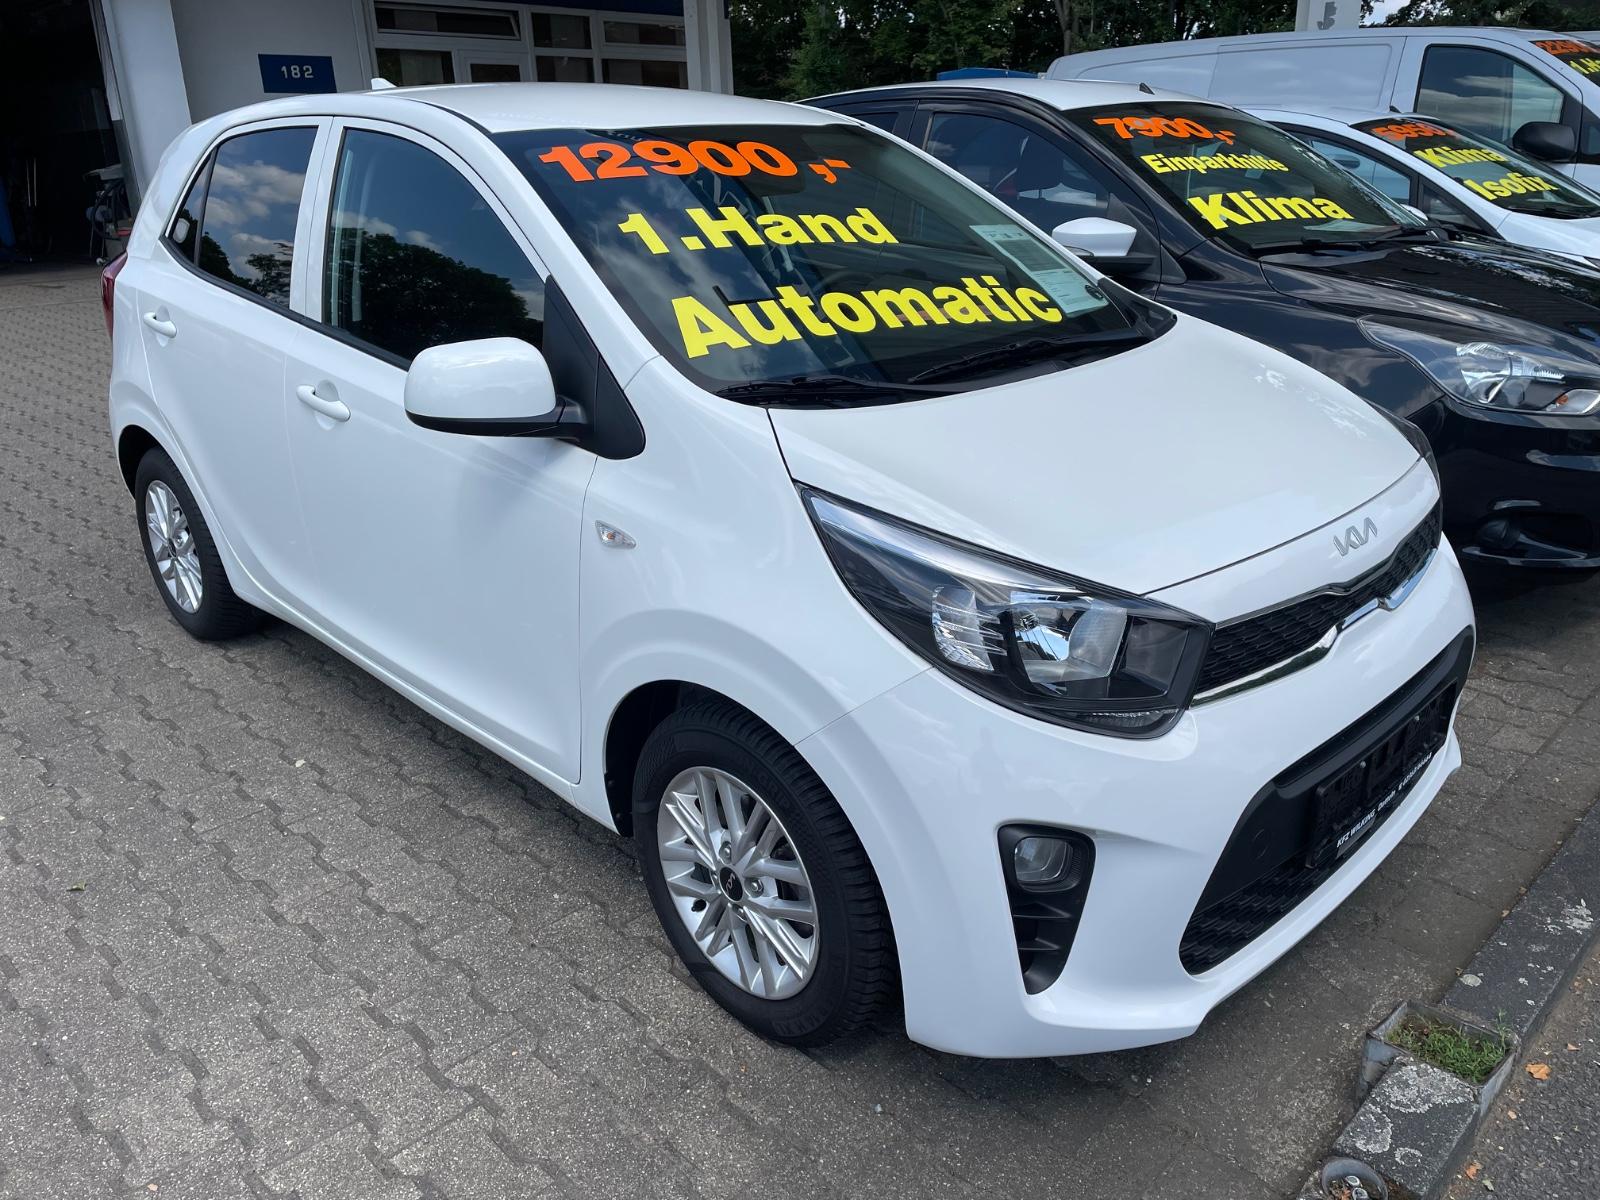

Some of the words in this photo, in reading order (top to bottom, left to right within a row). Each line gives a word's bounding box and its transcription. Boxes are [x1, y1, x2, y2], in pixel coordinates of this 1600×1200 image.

[281, 65, 314, 79] 182
[1140, 153, 1289, 174] Einparkhilfe
[1413, 146, 1508, 168] Klima
[1463, 172, 1559, 201] Isofix
[1187, 190, 1355, 230] Klima
[618, 207, 898, 255] 1.Hand
[672, 275, 1062, 357] Automatic
